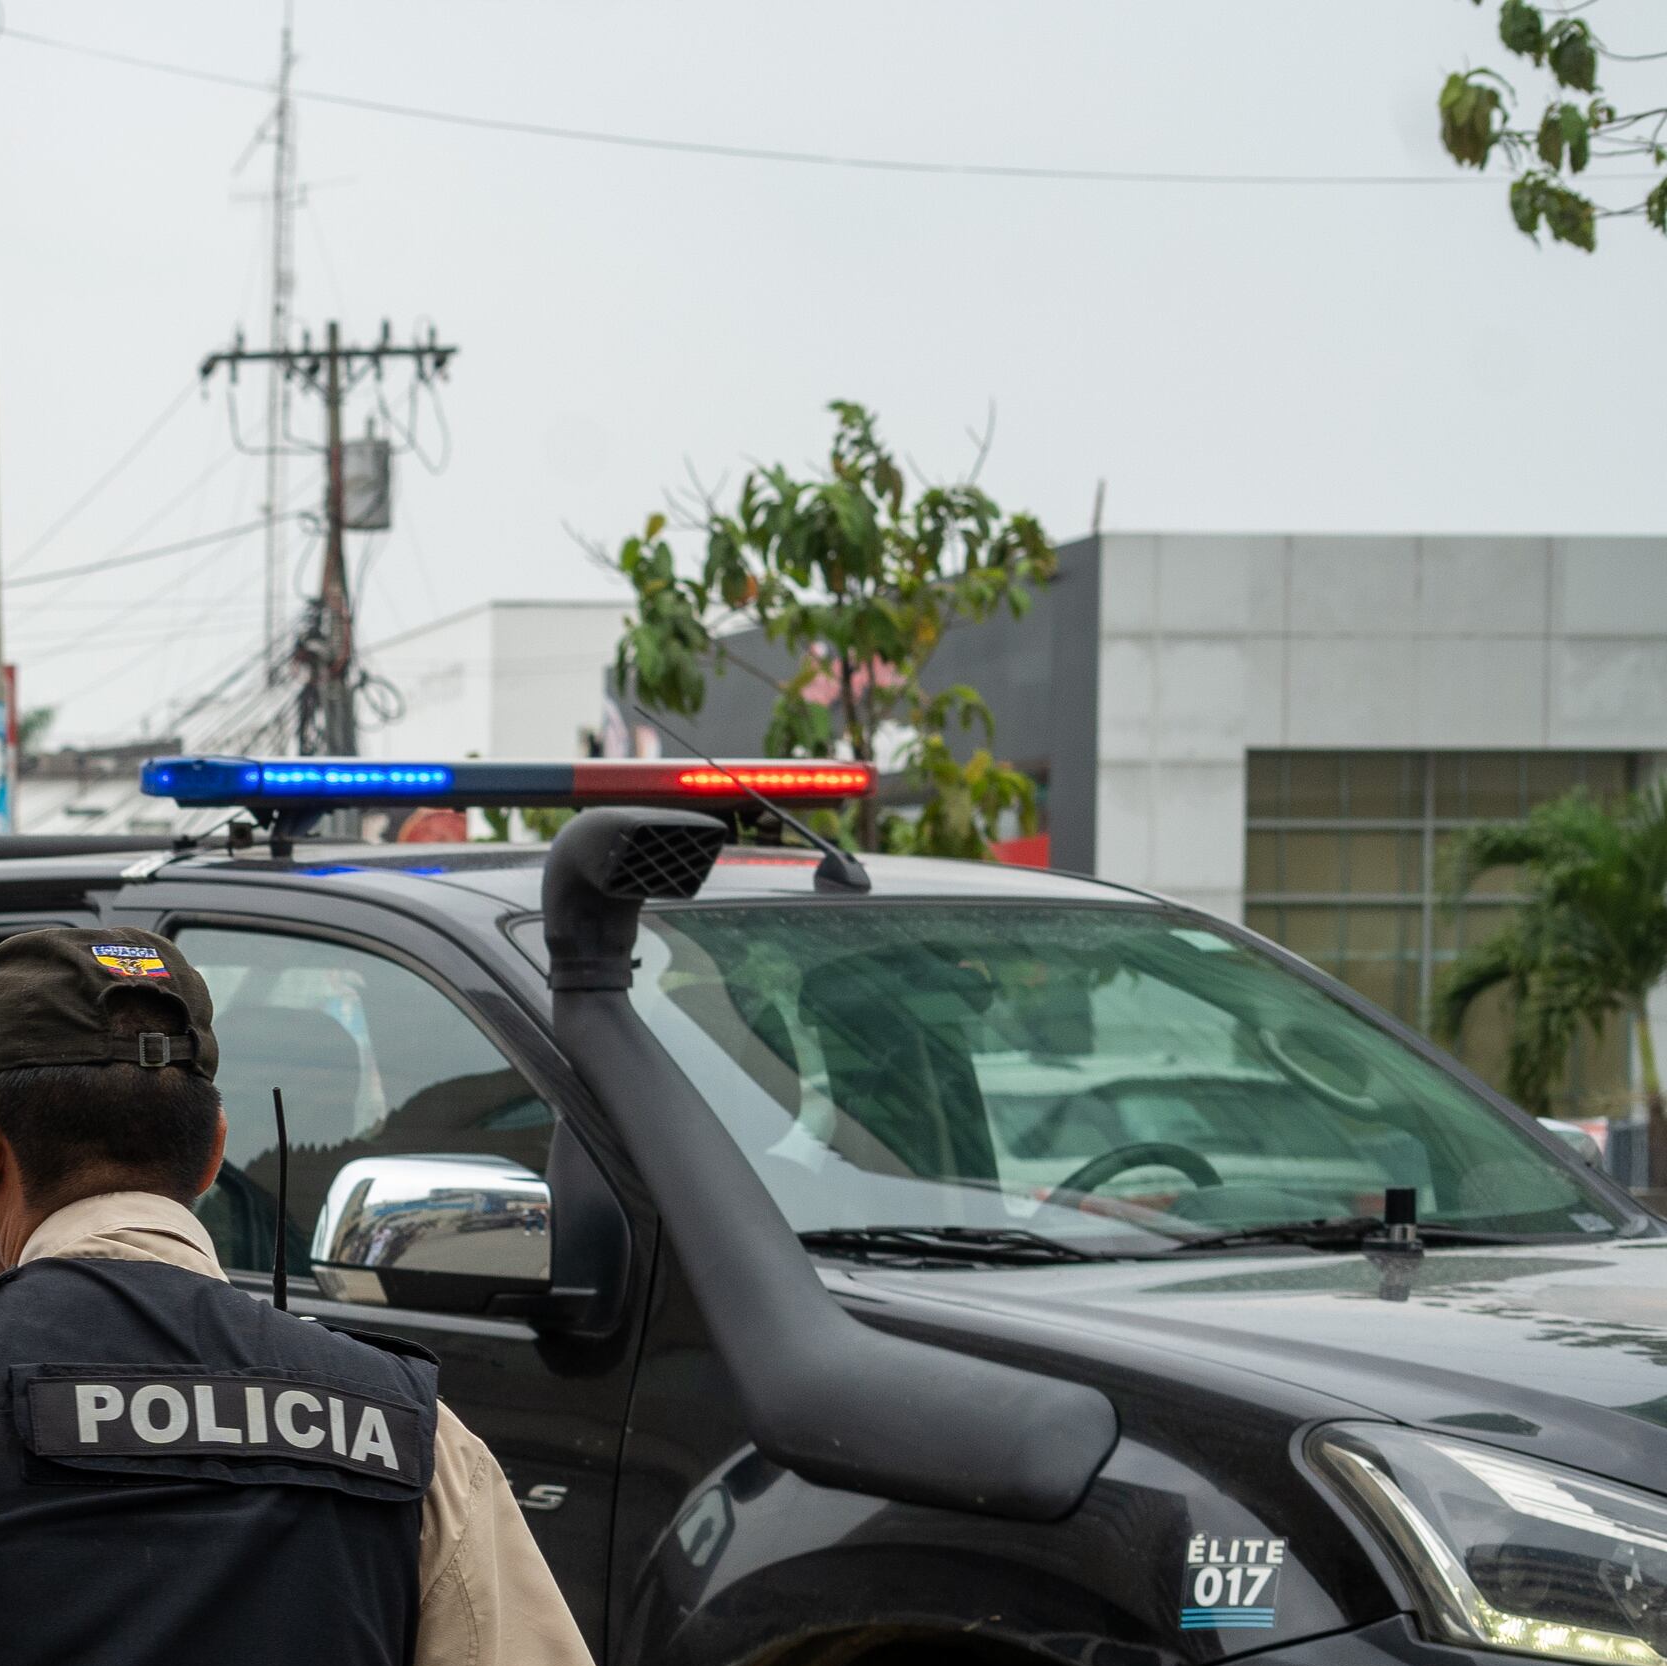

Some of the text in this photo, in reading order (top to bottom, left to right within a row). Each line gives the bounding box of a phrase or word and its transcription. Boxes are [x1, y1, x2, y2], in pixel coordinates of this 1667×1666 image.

[96, 945, 155, 958] ECUADOR
[74, 1384, 400, 1472] POLICIA
[1188, 1533, 1286, 1564] ÉLITE
[1193, 1566, 1273, 1608] 017
